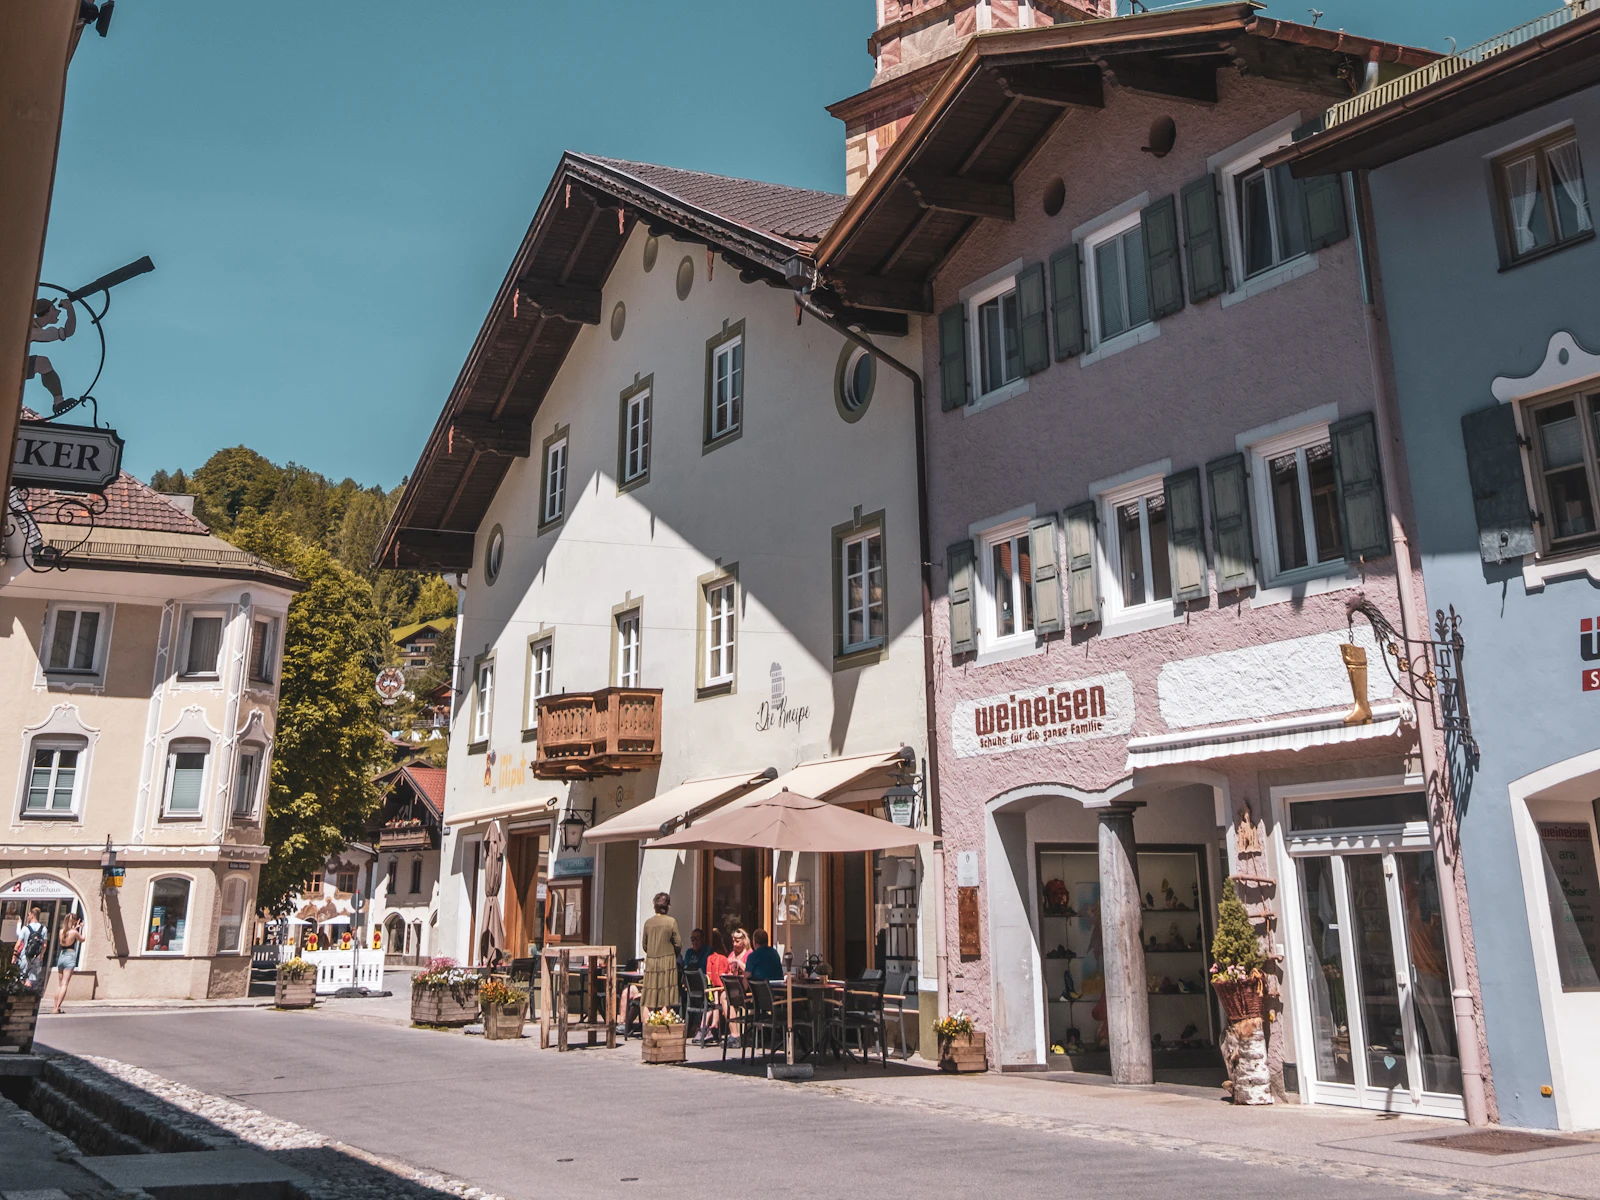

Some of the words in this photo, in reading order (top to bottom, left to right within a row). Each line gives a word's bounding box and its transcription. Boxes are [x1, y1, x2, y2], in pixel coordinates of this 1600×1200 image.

[14, 438, 101, 472] KER
[755, 700, 775, 732] Die
[776, 695, 811, 734] Kneipe
[975, 685, 1107, 736] weineisen
[980, 735, 1007, 749] Schuhe
[1010, 731, 1023, 744] für
[1026, 729, 1040, 741] die
[1043, 727, 1068, 742] ganze
[1071, 720, 1105, 735] Familie
[1540, 826, 1590, 838] weineisen
[1558, 850, 1576, 860] ara
